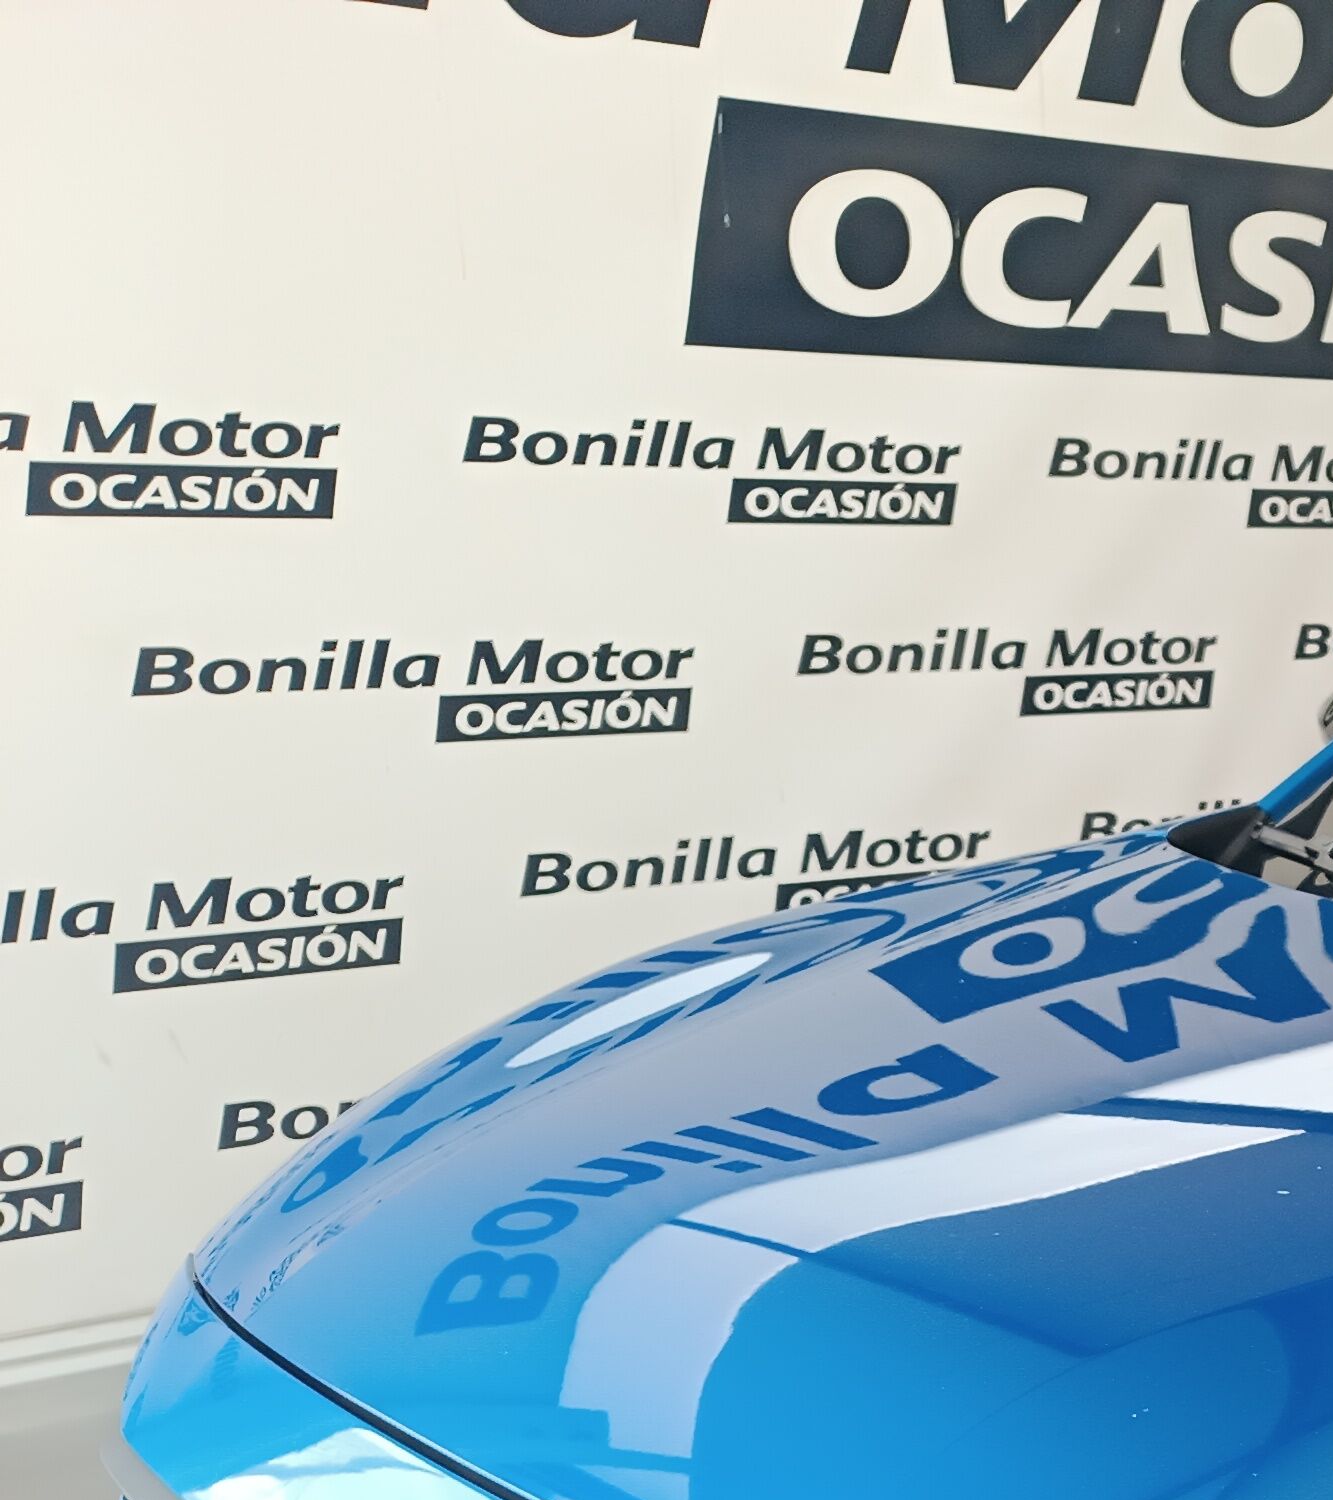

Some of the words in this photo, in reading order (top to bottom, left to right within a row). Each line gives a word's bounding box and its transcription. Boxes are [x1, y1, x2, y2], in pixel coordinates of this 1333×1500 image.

[62, 400, 341, 460] Motor
[462, 416, 734, 470] Bonilla
[756, 427, 960, 475] Motor
[1048, 438, 1254, 482] Bonilla
[49, 469, 321, 513] OCASIÓN
[744, 483, 946, 521] OCASIÓN
[131, 639, 439, 698] Bonilla
[466, 639, 695, 687] Motor
[795, 627, 1027, 676] Bonilla
[1045, 628, 1218, 668] Motor
[454, 691, 680, 737] OCASIÓN
[1033, 674, 1204, 711] OCASIÓN
[521, 837, 777, 898] Bonilla
[801, 829, 992, 874] Motor
[146, 876, 405, 934] Motor
[134, 926, 388, 985] OCASIÓN
